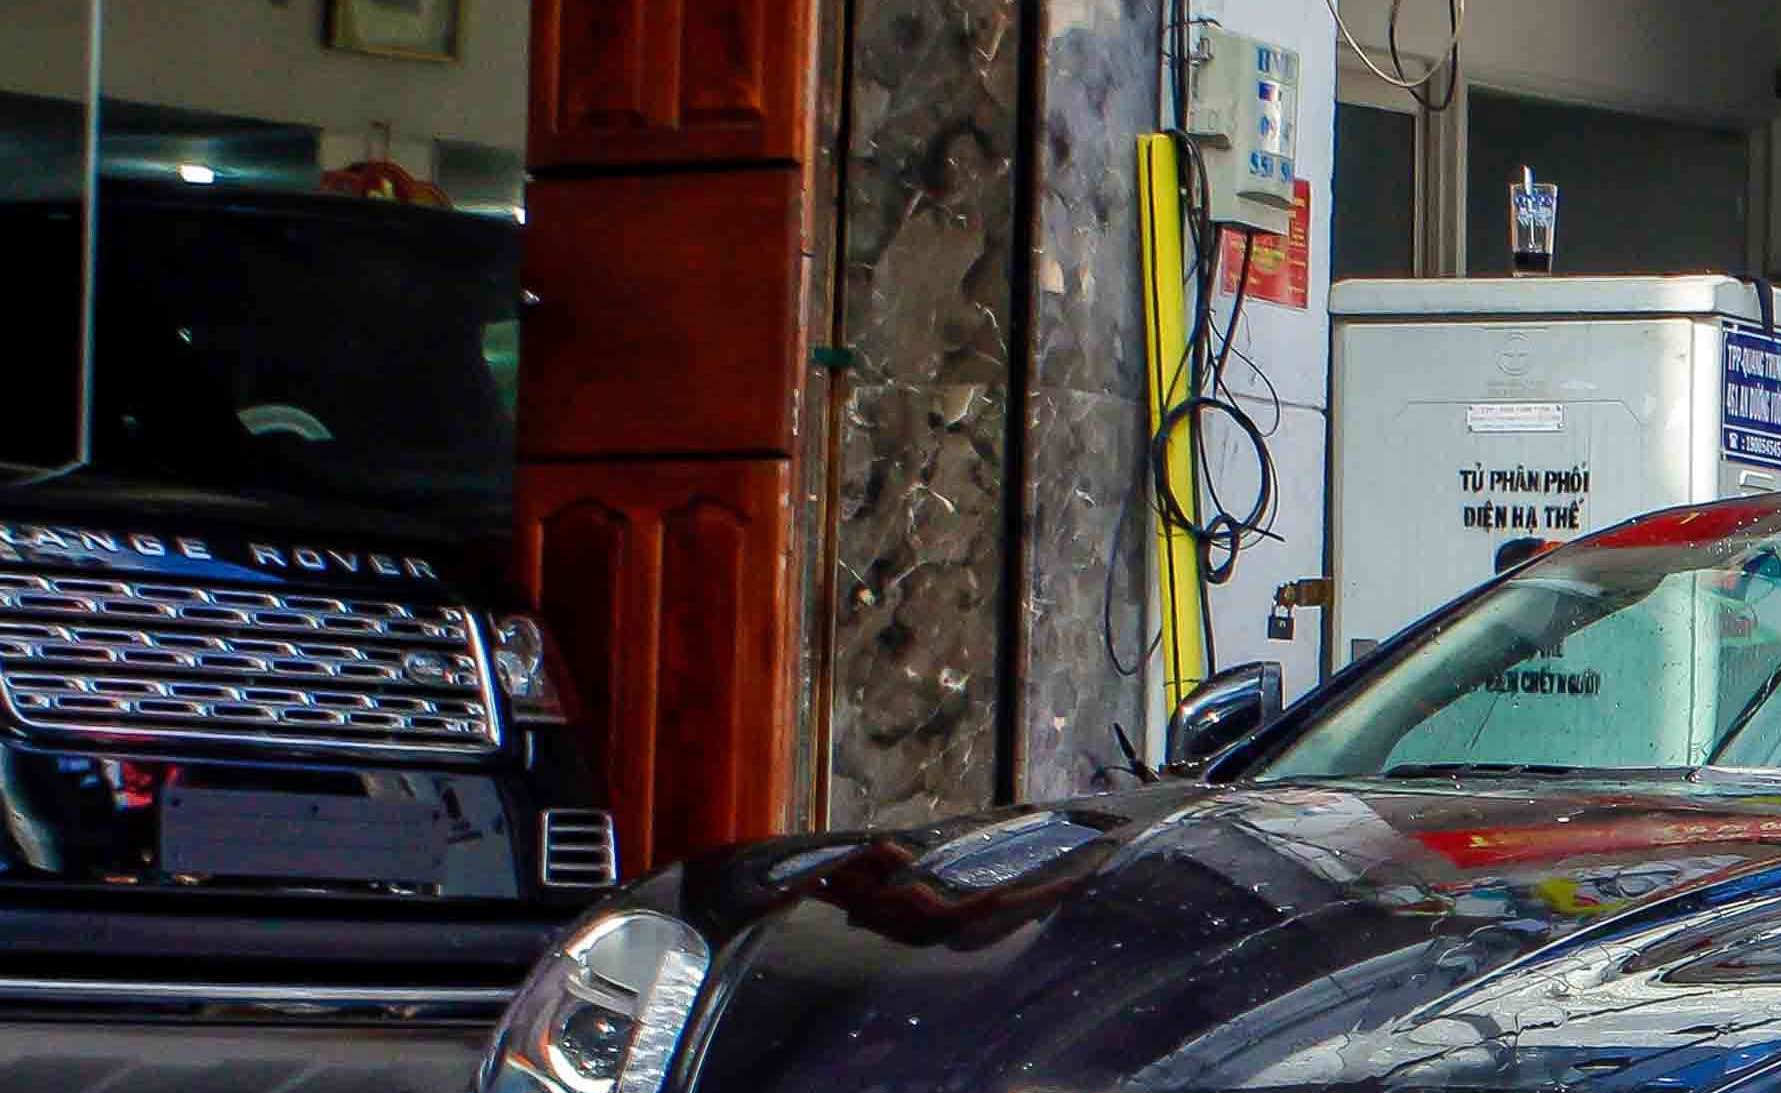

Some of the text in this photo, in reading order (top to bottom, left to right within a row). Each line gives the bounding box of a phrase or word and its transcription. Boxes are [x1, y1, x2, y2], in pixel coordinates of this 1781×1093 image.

[1459, 460, 1590, 493] TỦ PHÂN PHỐI
[1512, 505, 1539, 534] HẠ
[1543, 498, 1585, 530] THẾ
[249, 541, 438, 580] ROVER
